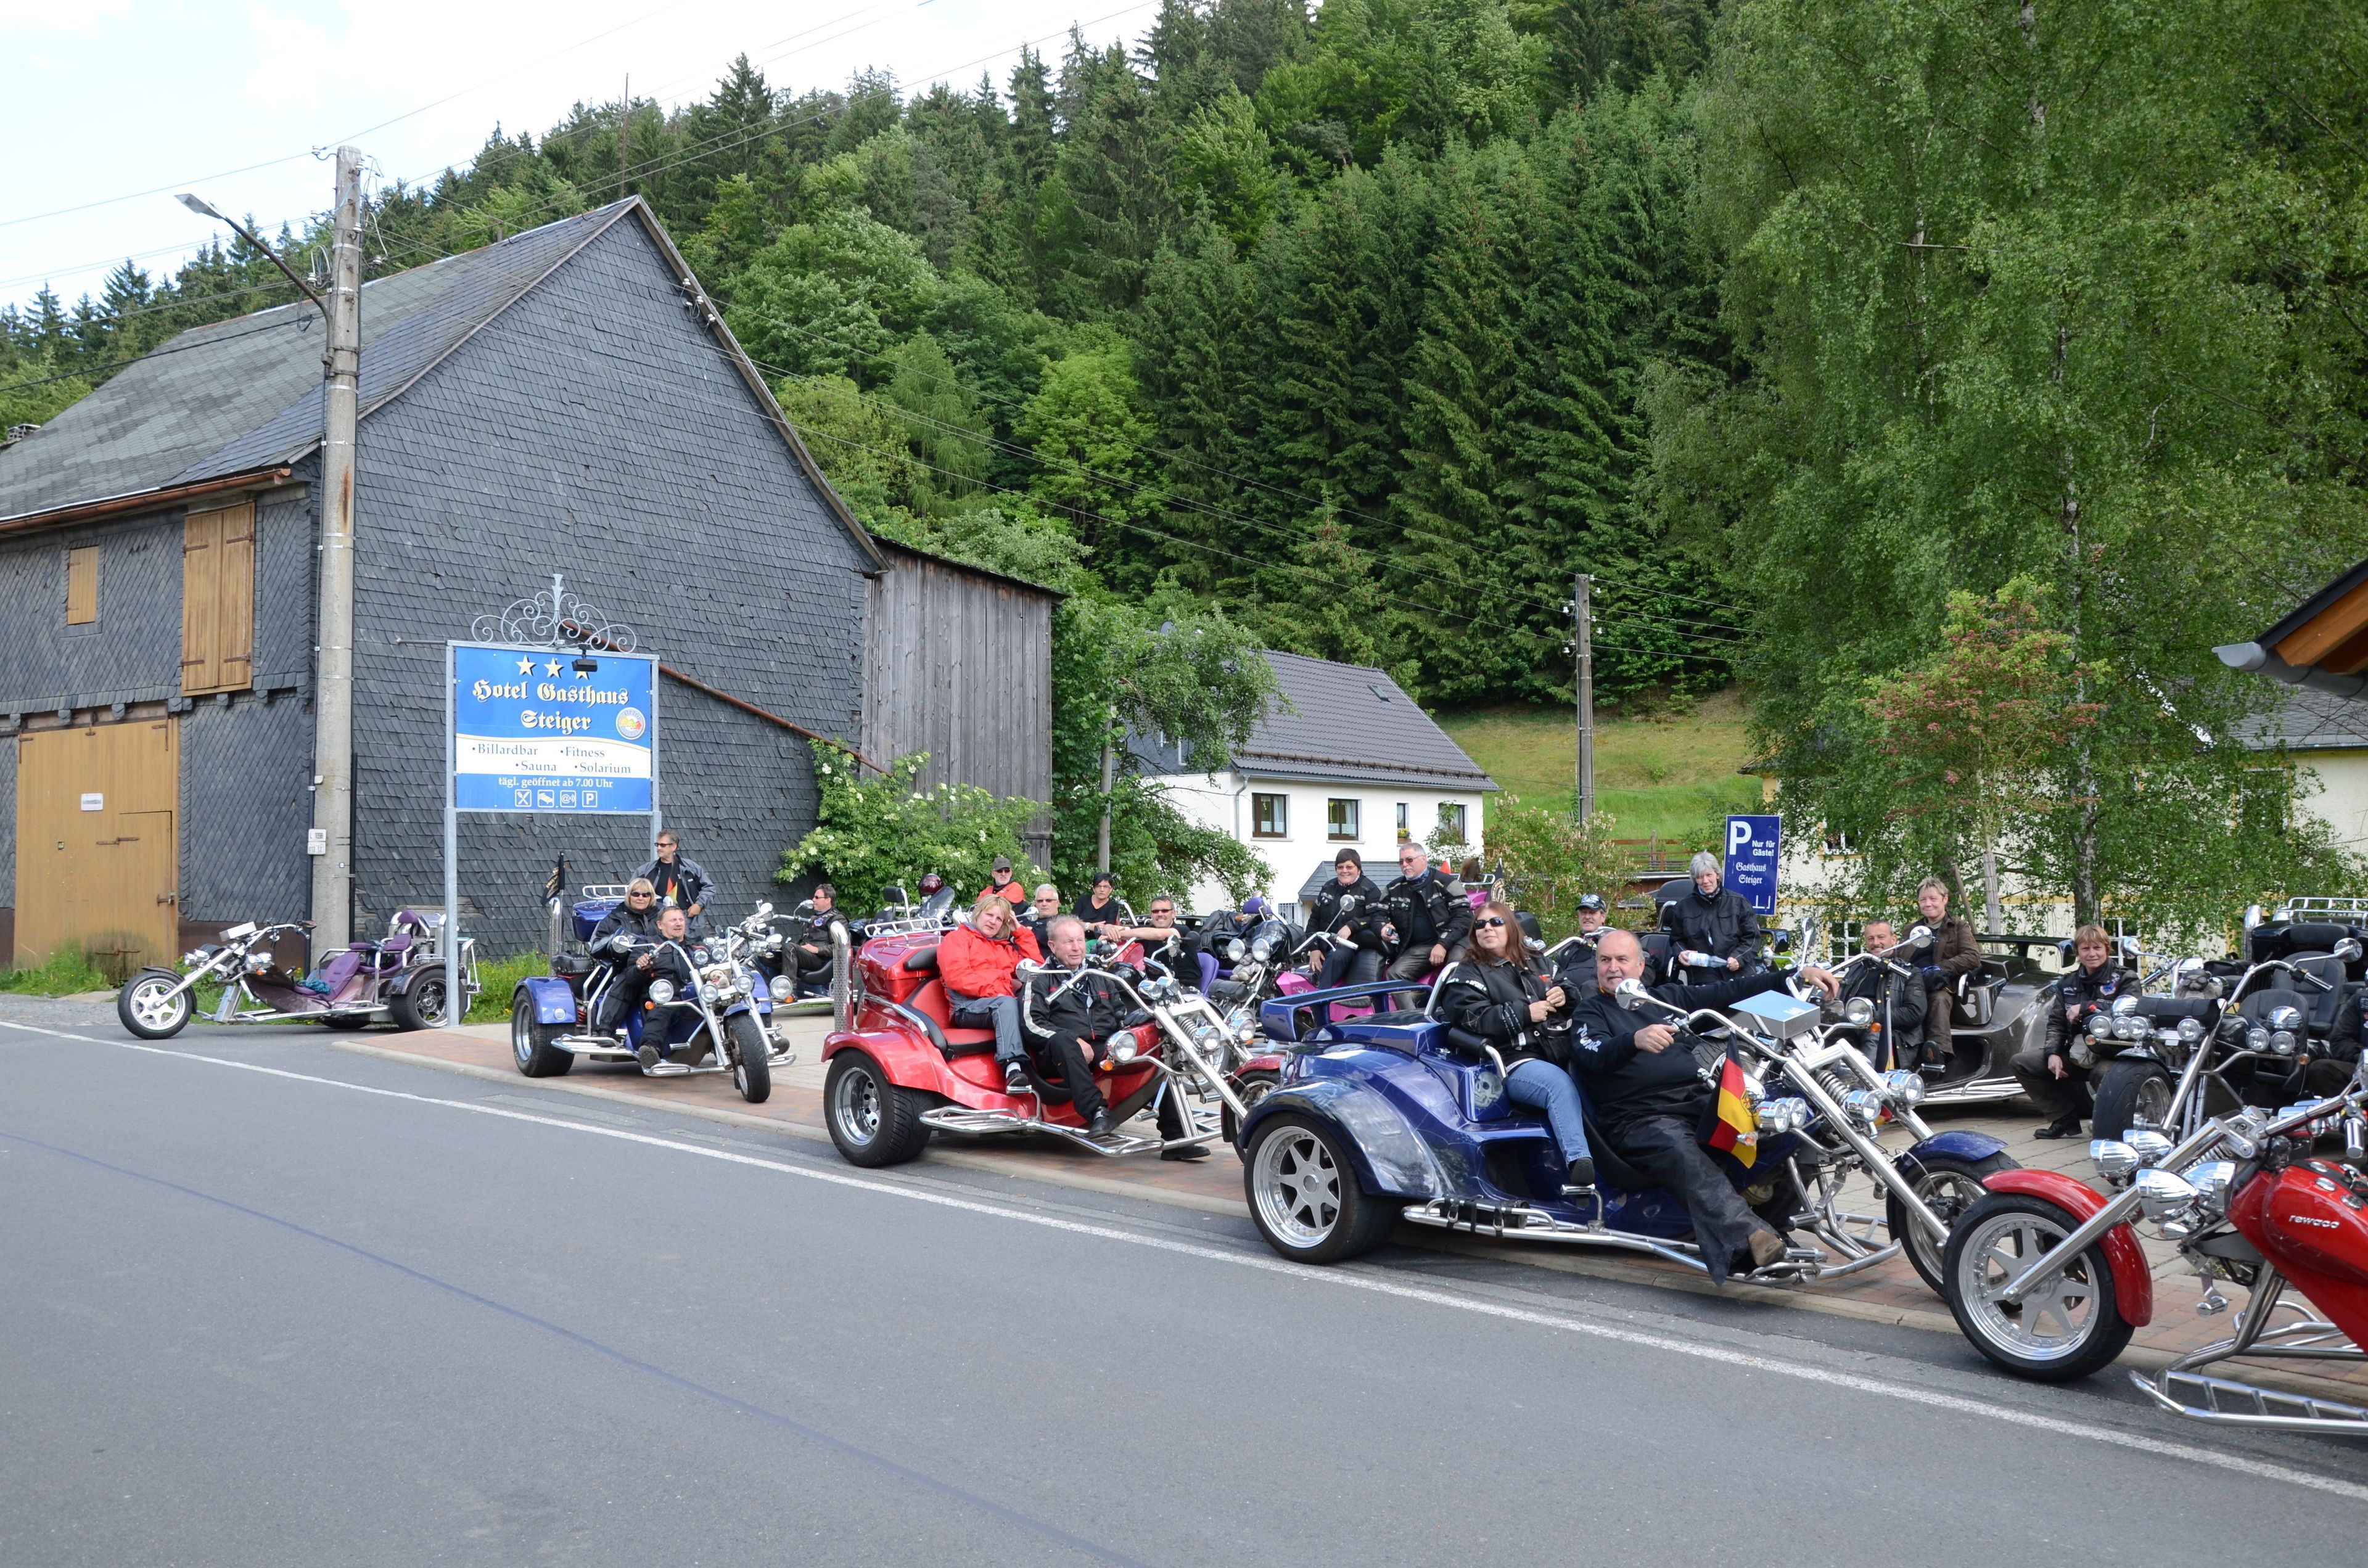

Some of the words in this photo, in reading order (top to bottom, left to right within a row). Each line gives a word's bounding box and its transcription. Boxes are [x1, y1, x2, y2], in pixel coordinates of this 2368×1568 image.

[473, 679, 528, 702] Hotel
[536, 683, 629, 708] Gasthaus
[520, 710, 592, 734] Steiger
[478, 744, 538, 755] Billardbar
[565, 747, 605, 757] Fitness
[521, 761, 556, 771] Sauna
[580, 763, 631, 773] Solarium
[498, 777, 519, 787] tägl.
[521, 777, 561, 788] geöffnet
[562, 778, 574, 787] ab
[575, 779, 593, 787] 7.00
[595, 779, 613, 788] Uhr
[1729, 821, 1752, 855] P
[1736, 862, 1766, 873] Gasthaus
[1738, 874, 1762, 885] Steiger
[2288, 1215, 2340, 1229] rewaco
